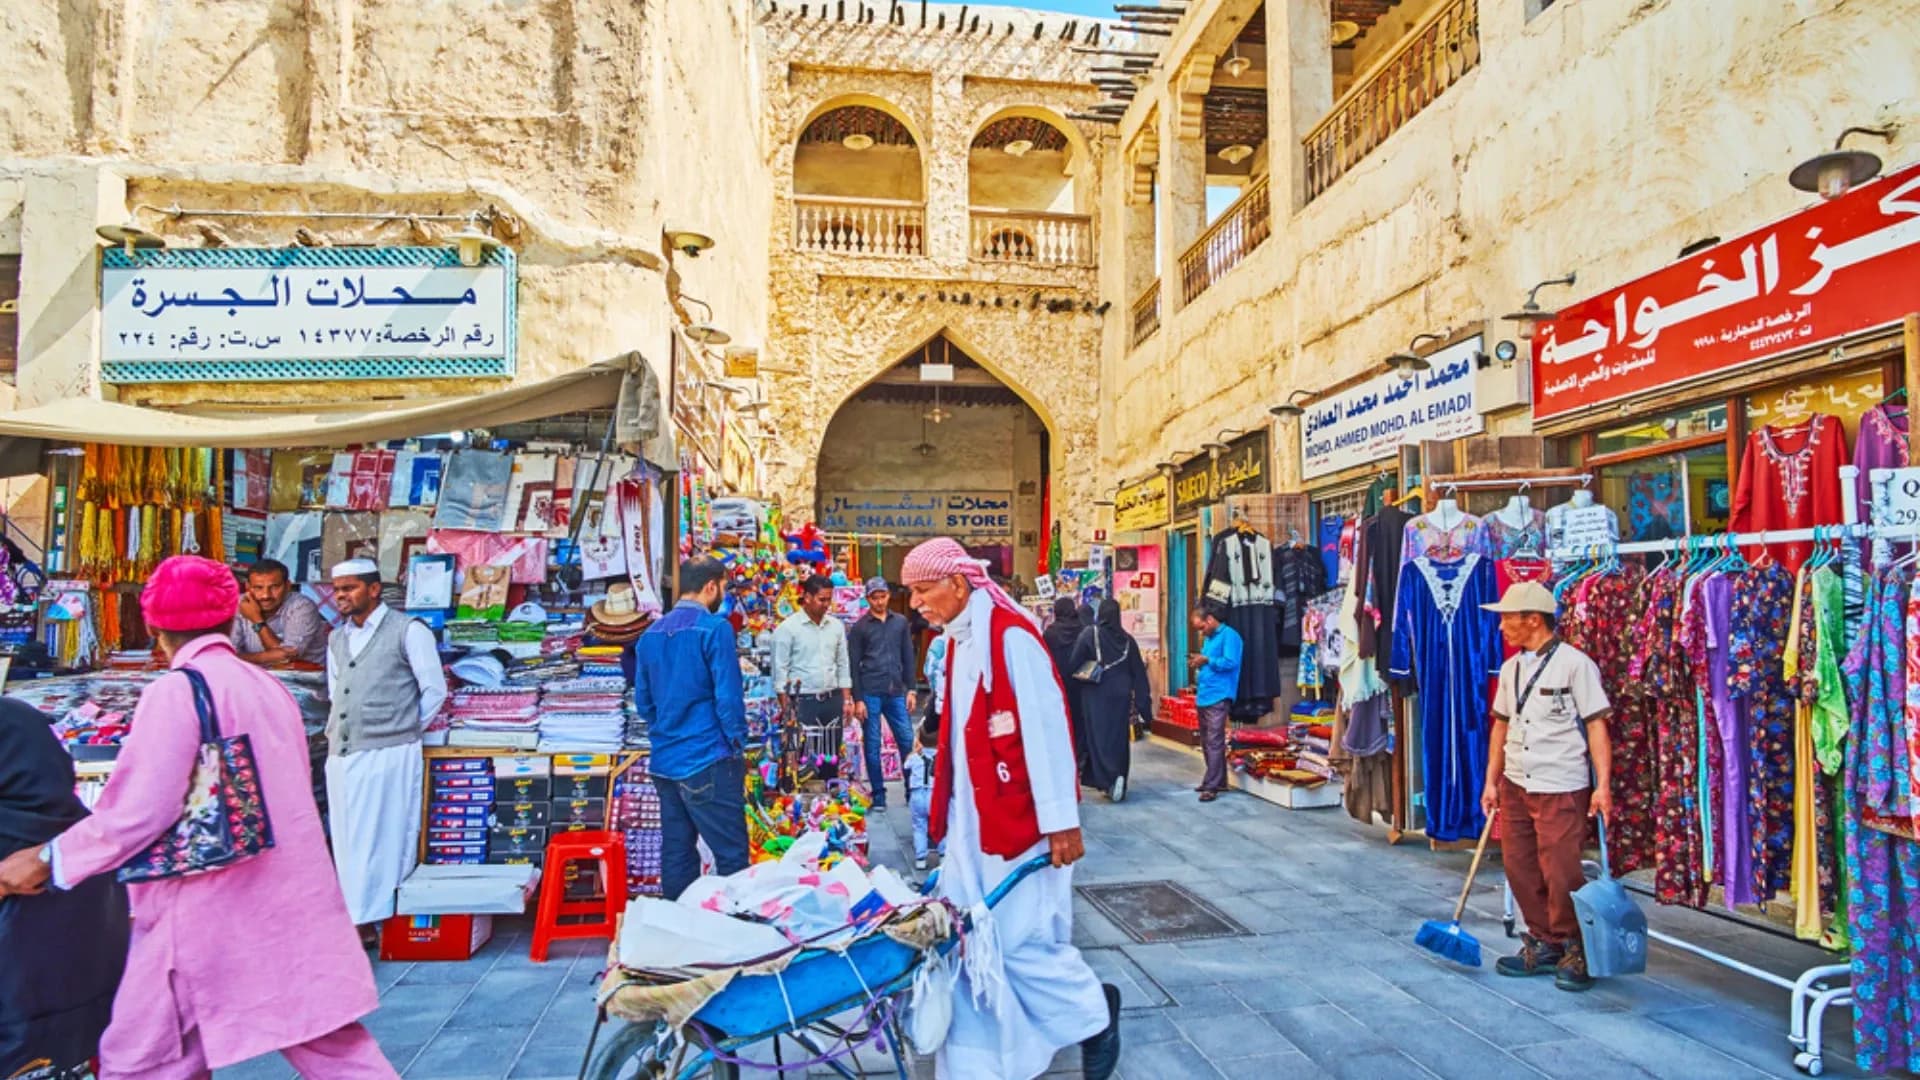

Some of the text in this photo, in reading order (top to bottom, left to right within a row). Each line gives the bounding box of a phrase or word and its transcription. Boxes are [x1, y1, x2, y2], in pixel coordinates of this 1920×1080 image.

[131, 274, 477, 318] محلات الجسرة
[1540, 233, 1780, 365] الخواجة
[119, 332, 155, 346] ٢٢٤
[463, 323, 494, 347] رقم
[1425, 357, 1470, 390] محمد
[1346, 392, 1379, 419] محمد
[1334, 425, 1369, 451] AHMED
[1409, 408, 1426, 426] AL
[1428, 393, 1472, 420] EMADI
[947, 496, 1009, 510] محلات
[824, 514, 1009, 528] AL SHAMAL STORE
[996, 761, 1011, 783] 6
